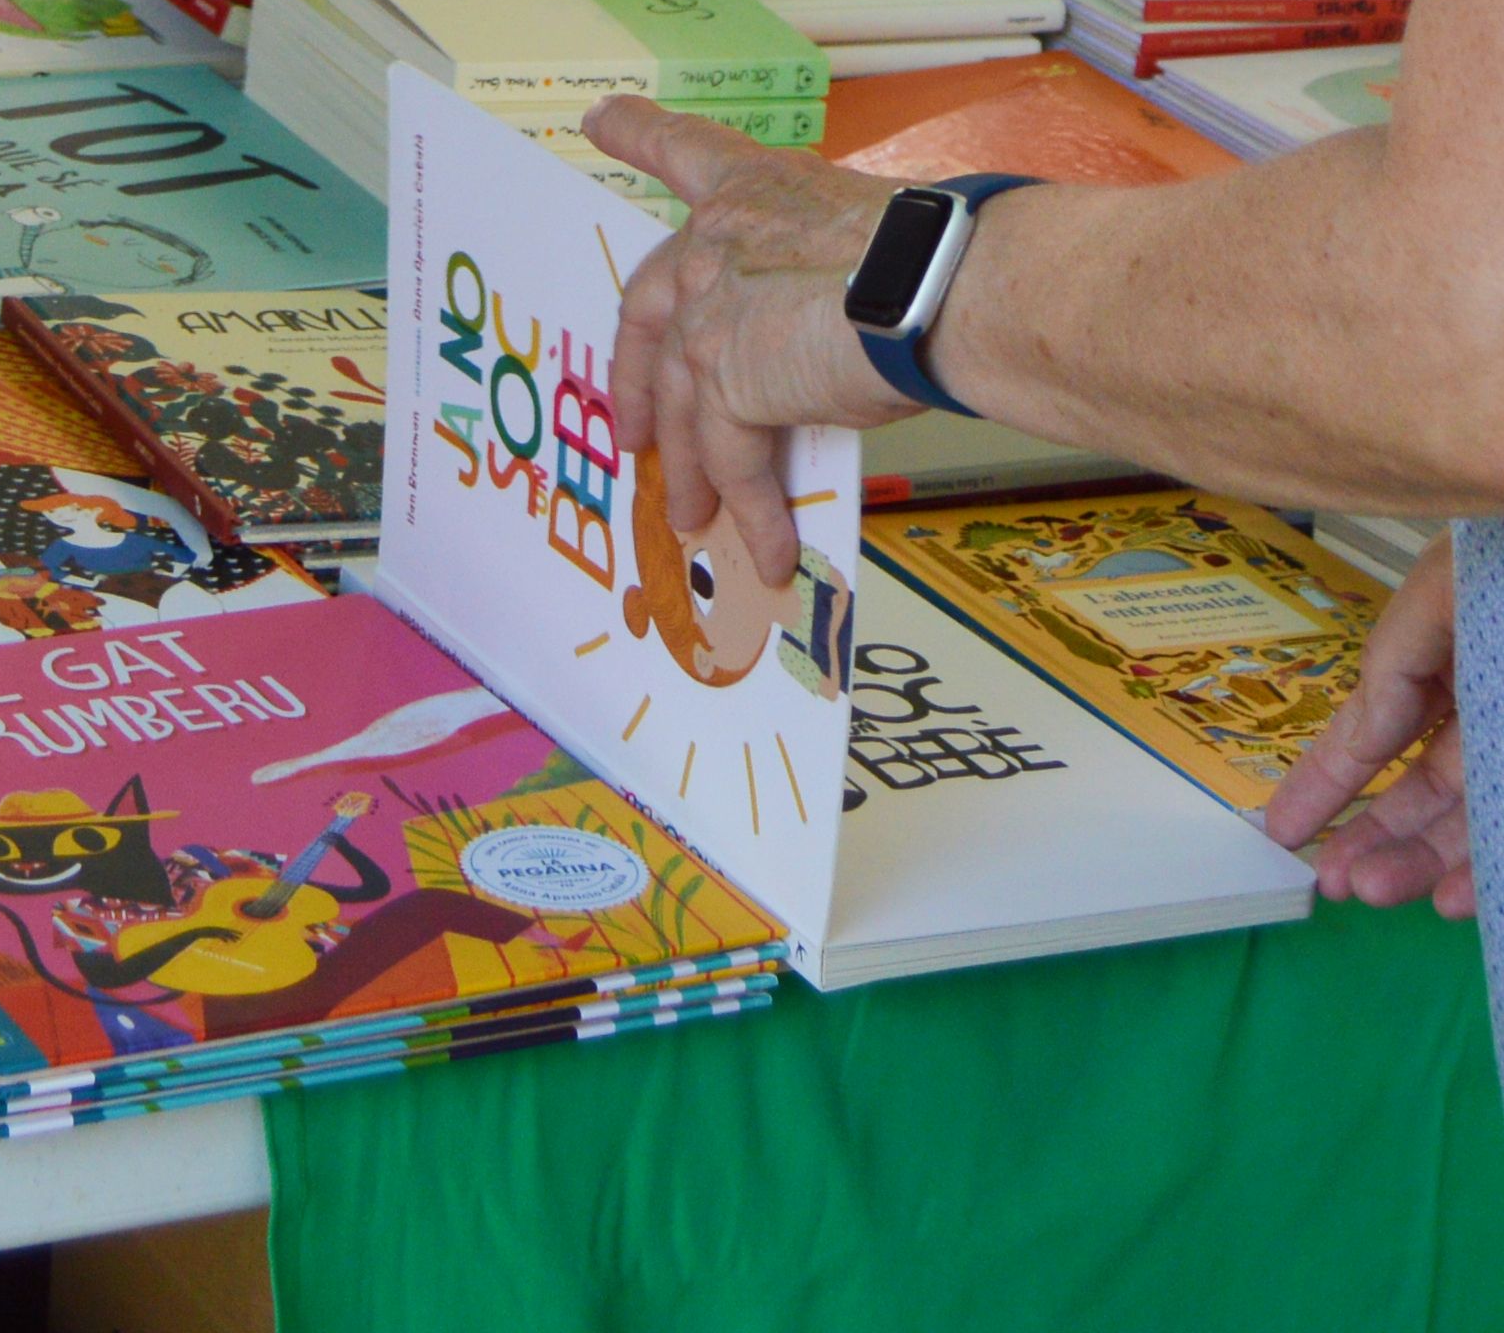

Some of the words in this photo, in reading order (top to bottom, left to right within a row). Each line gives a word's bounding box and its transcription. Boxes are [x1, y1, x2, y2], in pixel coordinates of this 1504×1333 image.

[439, 251, 489, 385] NO
[488, 290, 542, 519] SOC
[434, 402, 484, 489] JA
[1084, 581, 1238, 605] L'abecedari
[1101, 594, 1265, 619] entremaliat
[41, 631, 206, 691] GAT
[498, 862, 616, 878] PEGATINA
[501, 881, 536, 898] Anna
